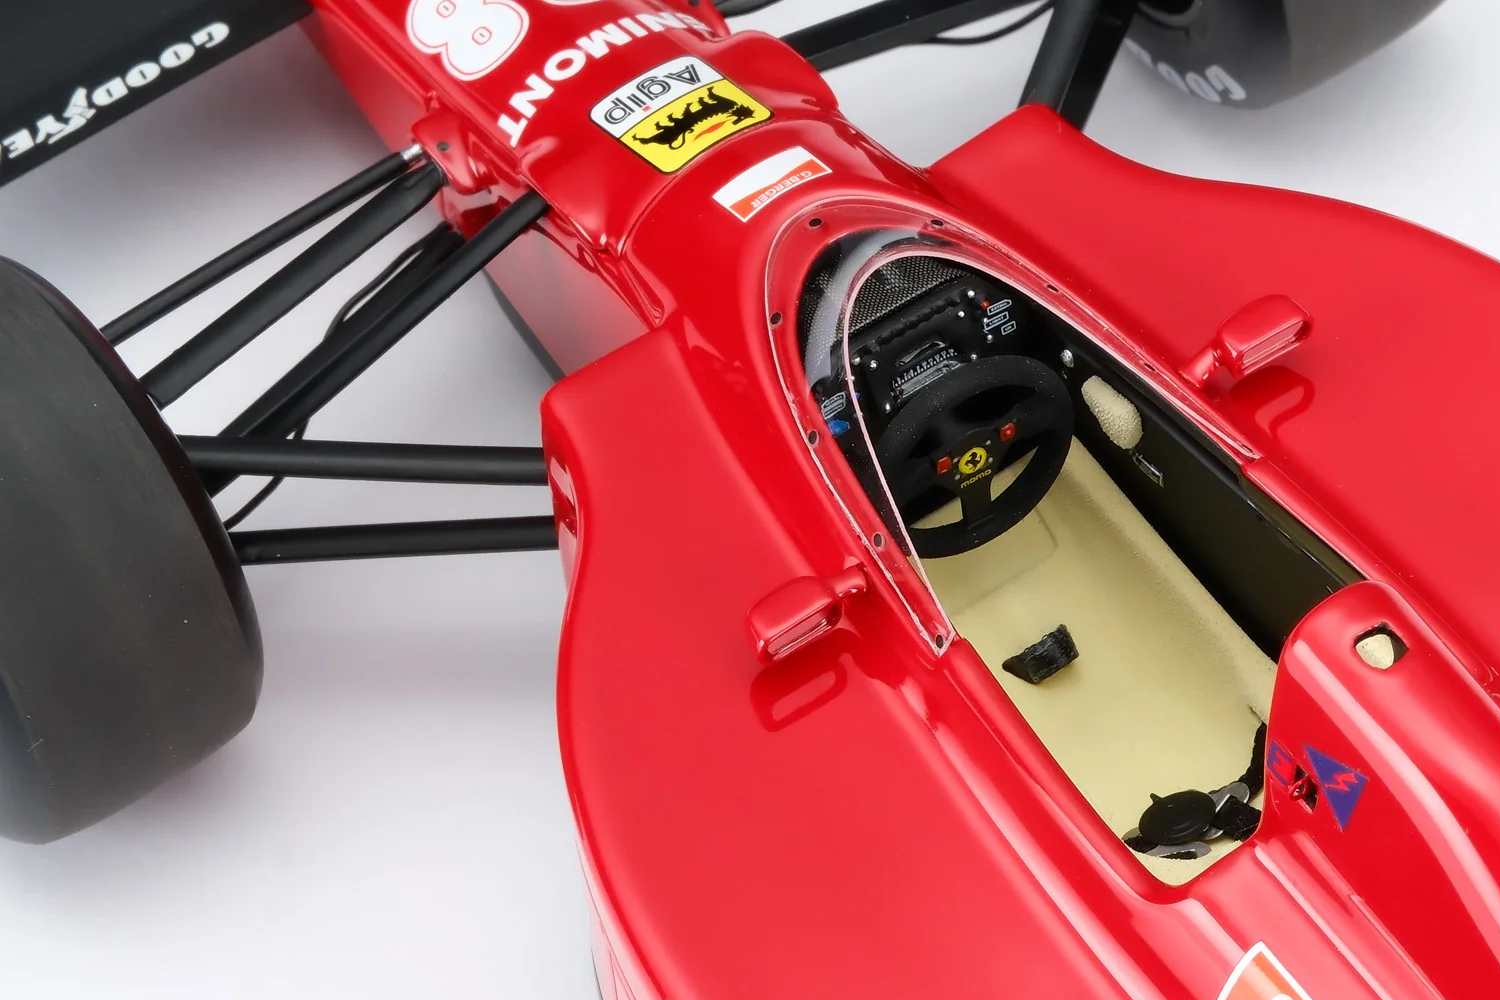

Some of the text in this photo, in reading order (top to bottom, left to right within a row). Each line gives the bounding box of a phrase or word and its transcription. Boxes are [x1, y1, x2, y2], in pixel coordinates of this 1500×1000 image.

[0, 21, 231, 159] GOODYE
[603, 63, 702, 126] Agip
[749, 170, 813, 209] G.BERGER
